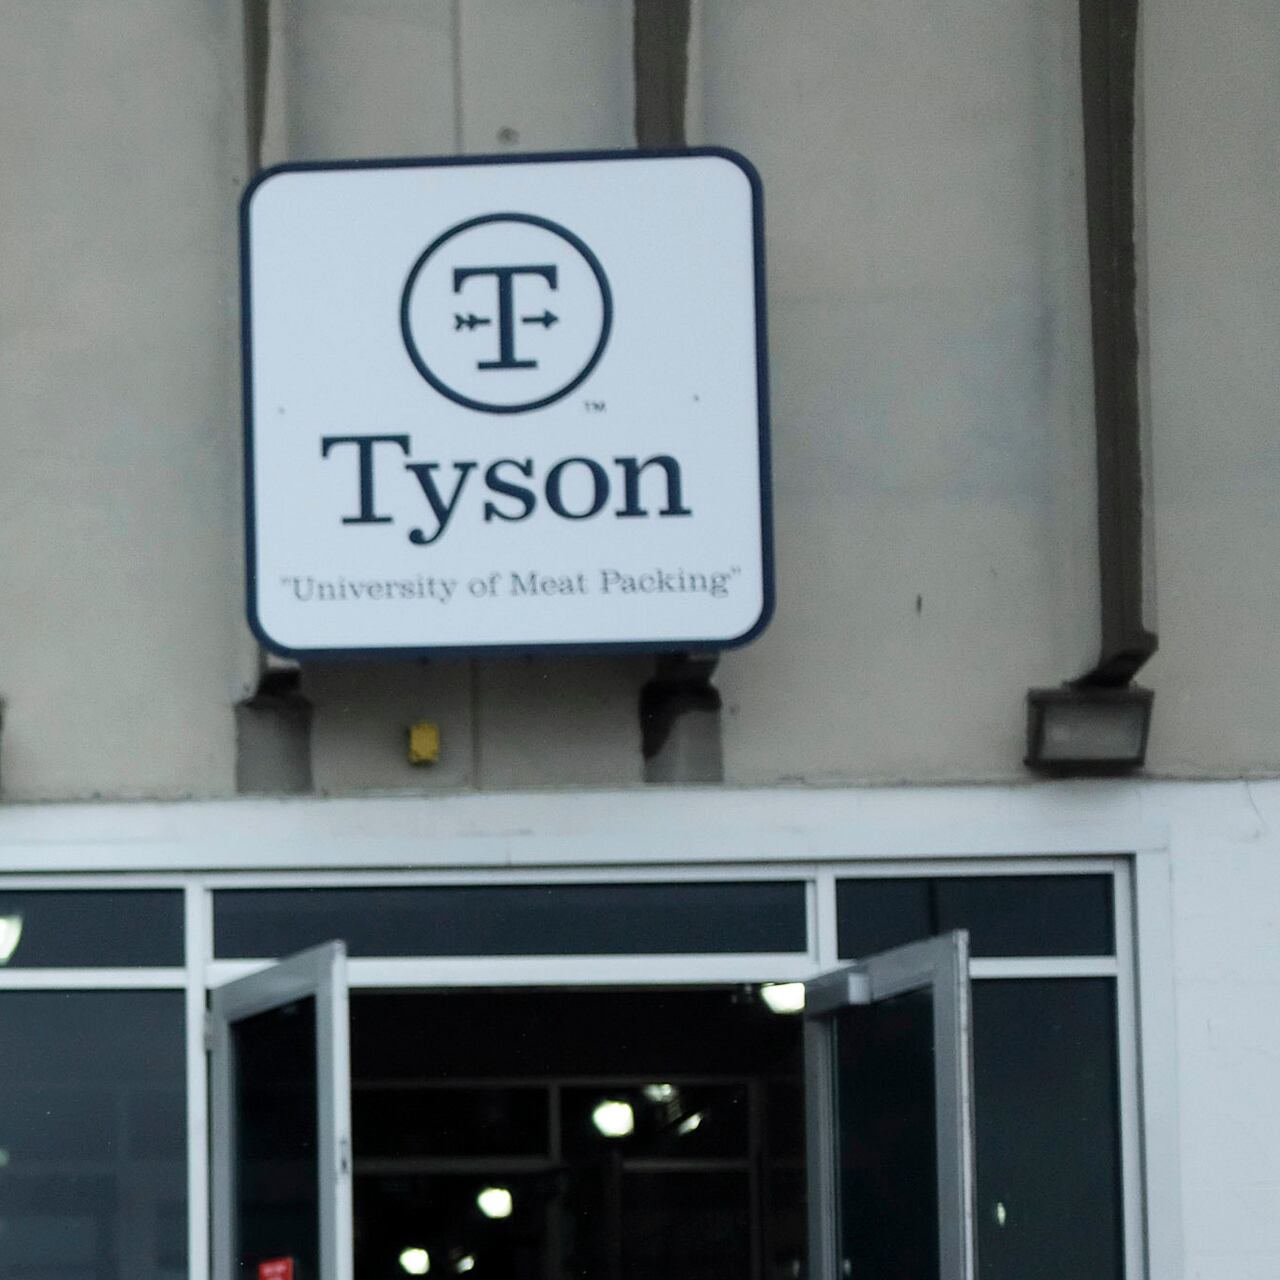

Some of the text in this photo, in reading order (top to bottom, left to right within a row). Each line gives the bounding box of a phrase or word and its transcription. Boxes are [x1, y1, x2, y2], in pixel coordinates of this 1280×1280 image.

[453, 264, 559, 372] T
[321, 434, 694, 547] Tyson
[280, 566, 743, 604] "University of Meat Packing"
